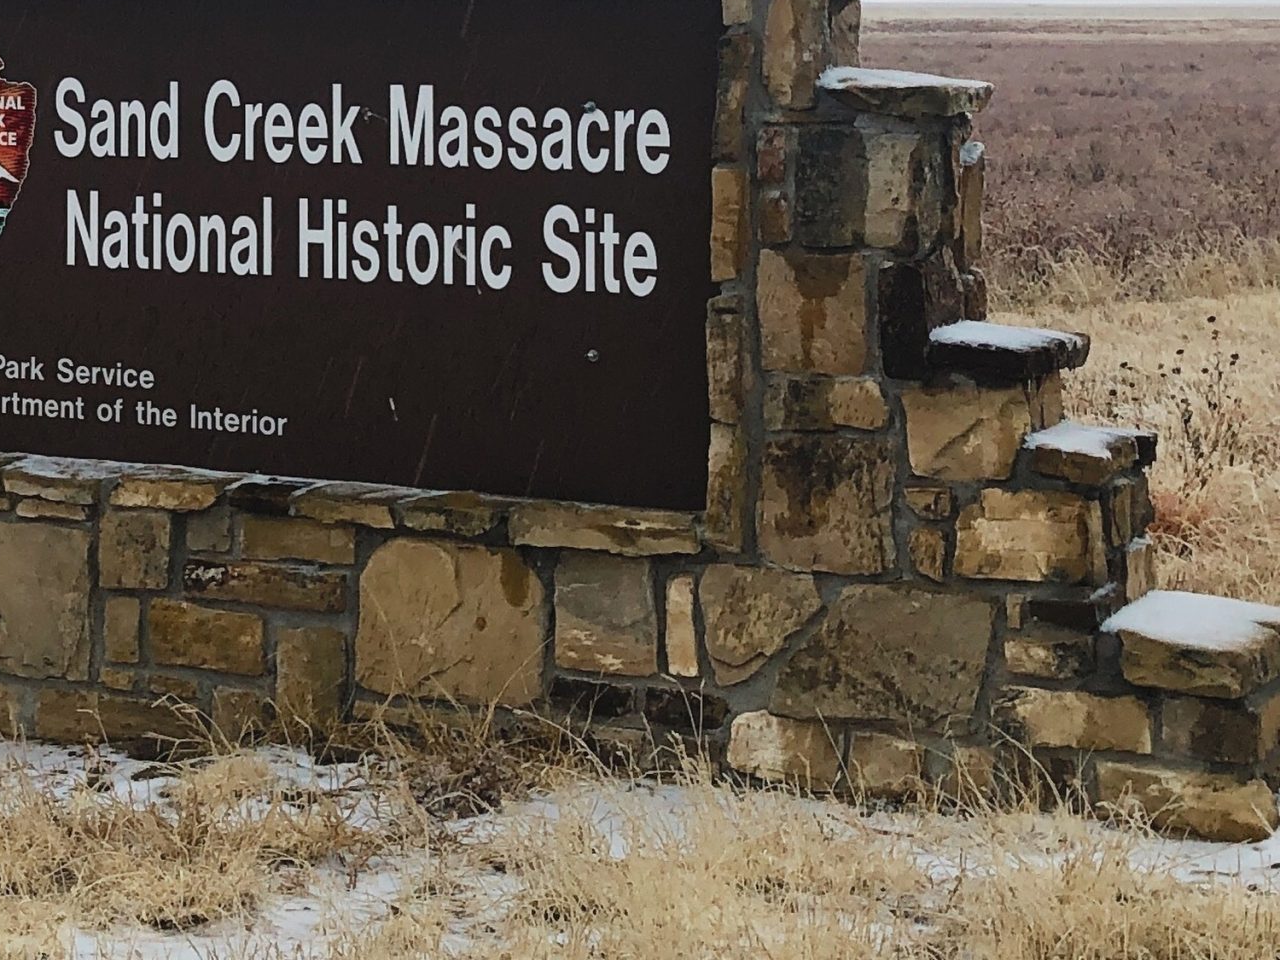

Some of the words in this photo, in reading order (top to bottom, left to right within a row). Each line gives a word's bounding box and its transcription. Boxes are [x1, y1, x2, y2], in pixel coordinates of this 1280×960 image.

[54, 76, 180, 161] Sand
[204, 79, 363, 165] Creek
[389, 84, 672, 175] Massacre
[66, 189, 274, 276] National
[298, 197, 512, 290] Historic
[541, 203, 659, 297] Site
[56, 357, 156, 389] Service
[96, 398, 124, 423] of
[134, 400, 178, 427] the
[190, 404, 288, 438] Interior
